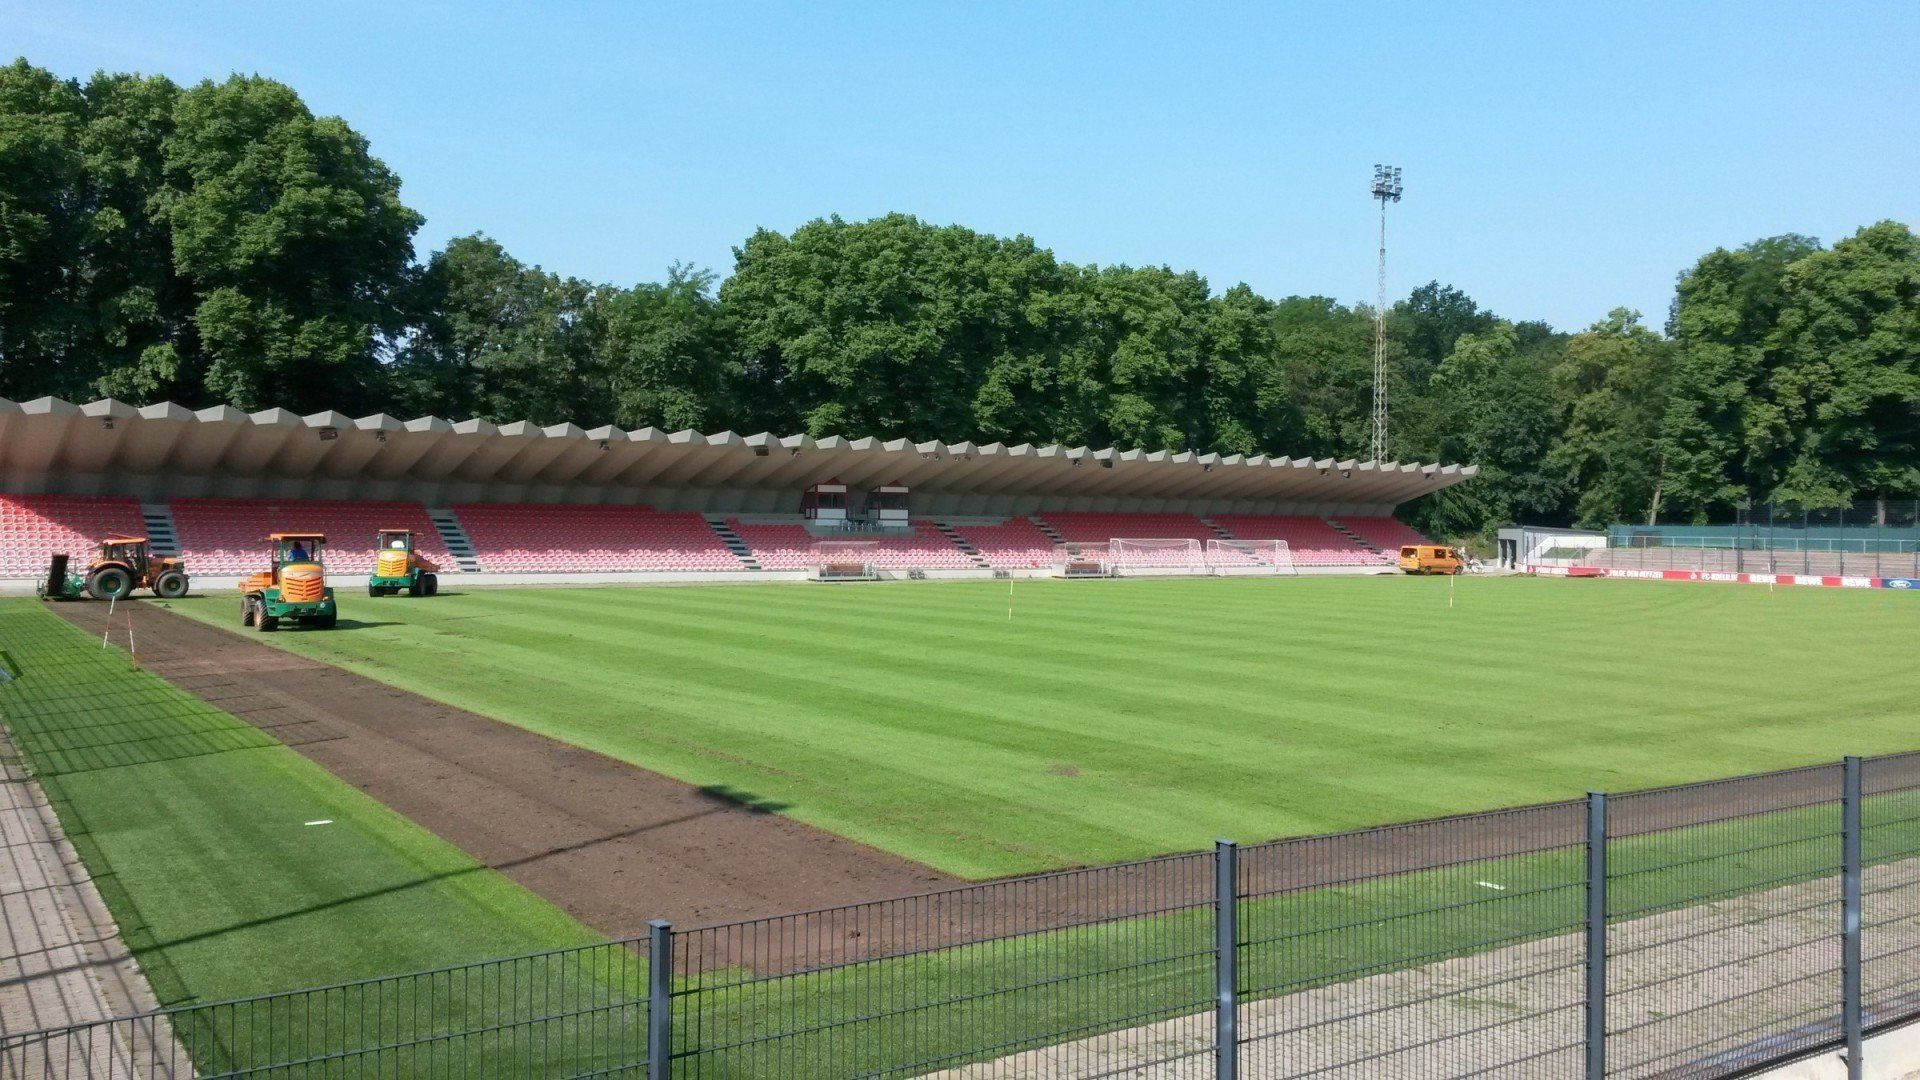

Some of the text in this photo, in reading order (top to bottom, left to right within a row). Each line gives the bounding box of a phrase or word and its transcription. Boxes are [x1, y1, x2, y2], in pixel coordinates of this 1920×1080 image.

[1749, 574, 1777, 583] REWE
[1794, 575, 1823, 585] REWE
[1842, 577, 1871, 588] REWE
